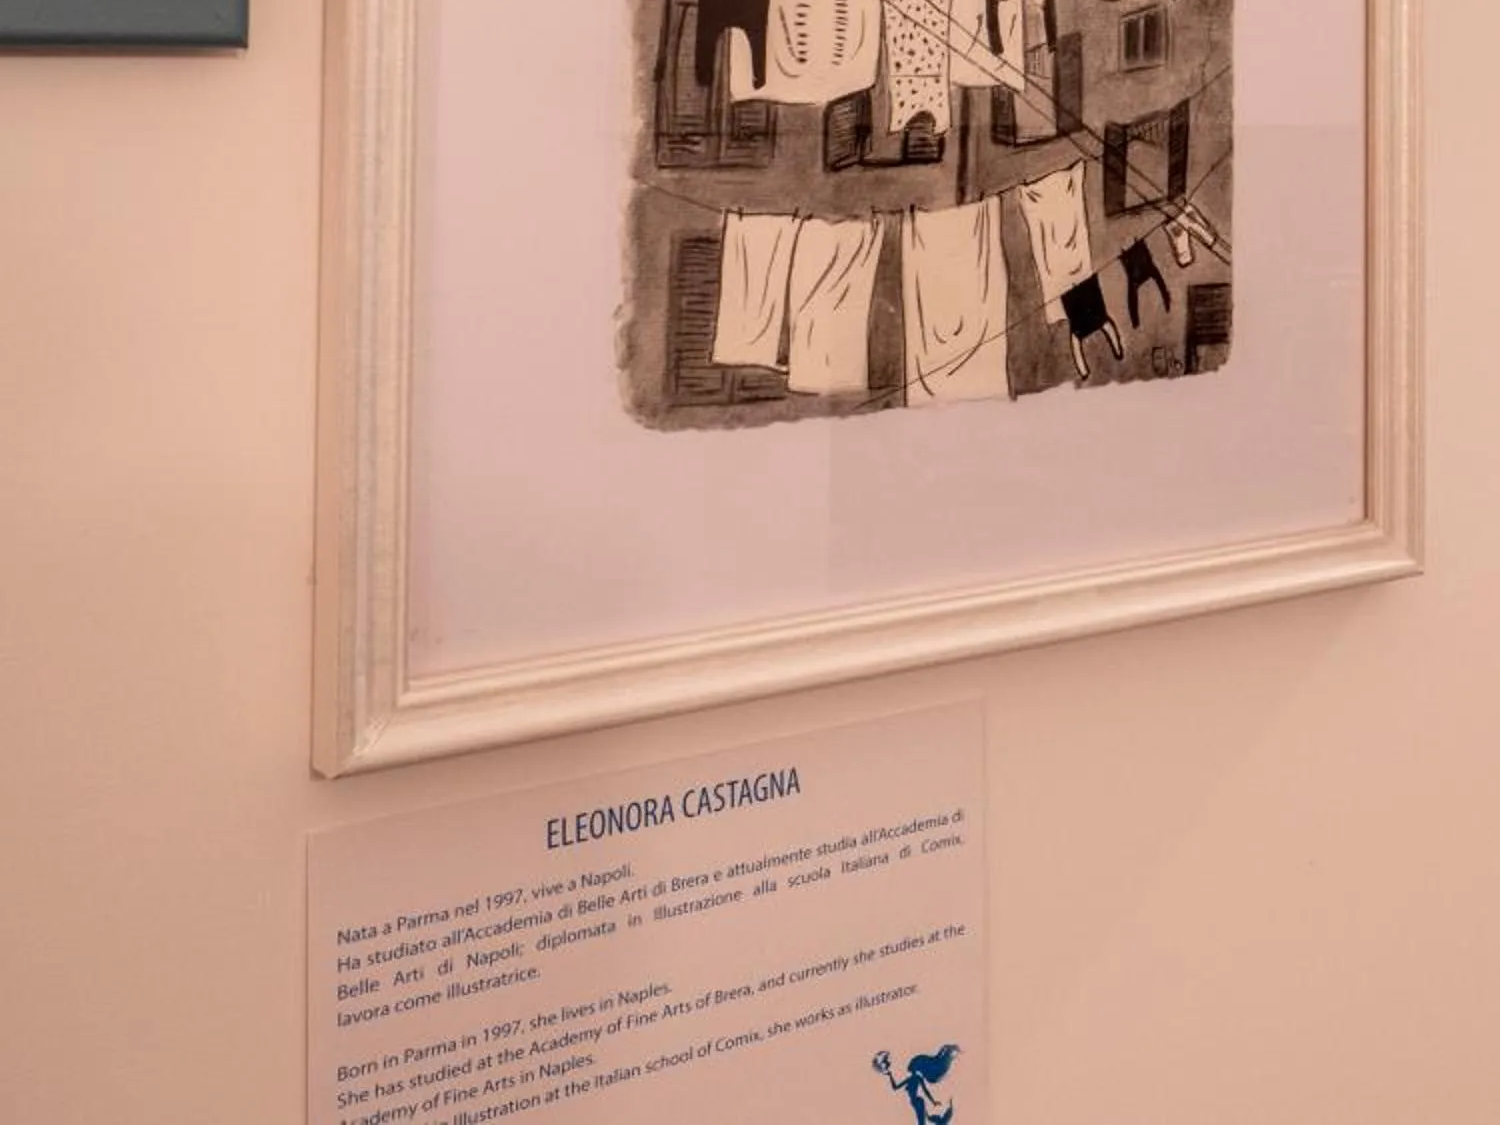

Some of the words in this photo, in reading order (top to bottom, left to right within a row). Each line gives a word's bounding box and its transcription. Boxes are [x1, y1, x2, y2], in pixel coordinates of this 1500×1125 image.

[547, 795, 675, 849] ELEONORA
[682, 767, 801, 818] CASTAGNA
[337, 956, 361, 973] Ha
[368, 938, 437, 966] studiato
[557, 903, 573, 921] di
[577, 894, 615, 916] Belle
[619, 885, 647, 906] Arti
[652, 880, 667, 896] di
[671, 873, 709, 893] Brera
[713, 870, 721, 882] e
[727, 848, 813, 879] attualmente
[816, 836, 857, 857] studia
[951, 808, 965, 824] di
[337, 927, 377, 945] Nata
[382, 923, 392, 935] a
[397, 910, 449, 932] Parma
[455, 899, 479, 918] nel
[532, 880, 563, 900] vive
[567, 879, 577, 892] a
[581, 863, 634, 888] Napoli.
[337, 979, 380, 1001] Belle
[393, 968, 424, 986] Arti
[437, 959, 453, 975] di
[536, 920, 616, 952] diplomata
[628, 913, 643, 928] in
[753, 880, 777, 896] alla
[788, 866, 831, 888] scuola
[899, 844, 911, 858] di
[337, 1004, 390, 1028] lavora
[394, 991, 441, 1012] come
[446, 966, 541, 1000] illustratrice.
[337, 1088, 369, 1109] She
[375, 1078, 404, 1098] has
[409, 1060, 472, 1088] studied
[477, 1055, 492, 1070] at
[497, 1045, 524, 1065] the
[529, 1025, 601, 1056] Academy
[607, 1017, 623, 1035] of
[627, 1009, 657, 1030] Fine
[661, 1001, 692, 1020] Arts
[695, 993, 710, 1011] of
[715, 984, 755, 1005] Brera,
[758, 973, 785, 993] and
[789, 955, 849, 983] currently
[853, 949, 874, 965] she
[879, 934, 925, 958] studies
[927, 930, 940, 944] at
[943, 924, 966, 940] the
[337, 1060, 378, 1082] Born
[383, 1053, 399, 1069] in
[403, 1040, 456, 1064] Parma
[461, 1034, 477, 1049] in
[529, 1010, 557, 1031] she
[561, 997, 596, 1022] lives
[600, 996, 613, 1011] in
[618, 981, 673, 1009] Naples.
[422, 1090, 440, 1112] of
[444, 1086, 478, 1106] Fine
[482, 1077, 515, 1094] Arts
[519, 1069, 535, 1084] in
[544, 1087, 560, 1103] at
[564, 1075, 589, 1096] the
[594, 1063, 641, 1090] Italian
[645, 1047, 694, 1073] school
[697, 1041, 713, 1058] of
[767, 1019, 791, 1039] she
[795, 1006, 836, 1030] works
[838, 1003, 852, 1018] as
